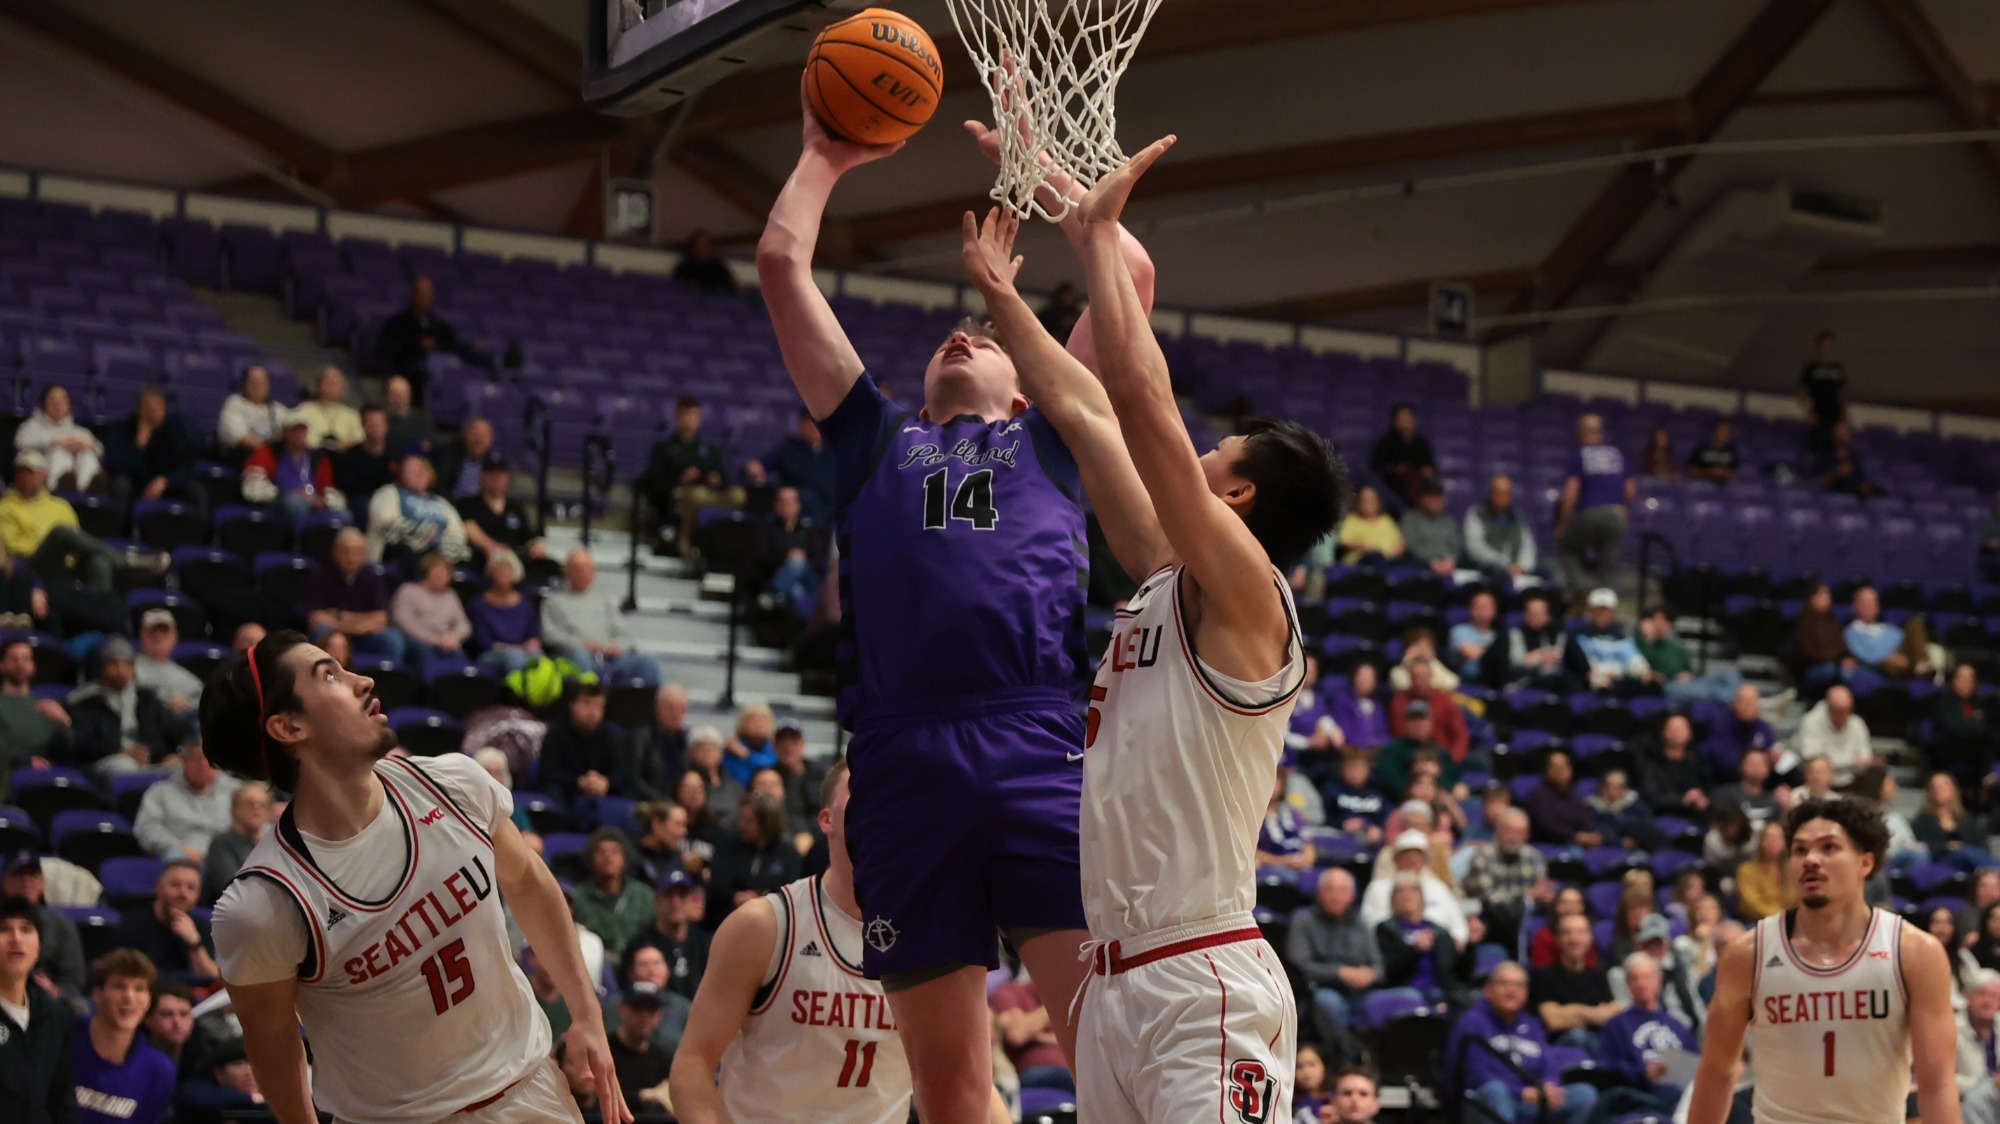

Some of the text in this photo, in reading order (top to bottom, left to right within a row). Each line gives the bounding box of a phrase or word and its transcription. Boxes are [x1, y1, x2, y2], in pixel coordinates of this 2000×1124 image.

[871, 22, 941, 82] Wilson
[898, 439, 1020, 469] Potland
[923, 467, 999, 531] 14
[421, 937, 475, 1016] 15
[791, 989, 898, 1030] SEATTL
[837, 1039, 878, 1087] 11
[1823, 1031, 1835, 1077] 1
